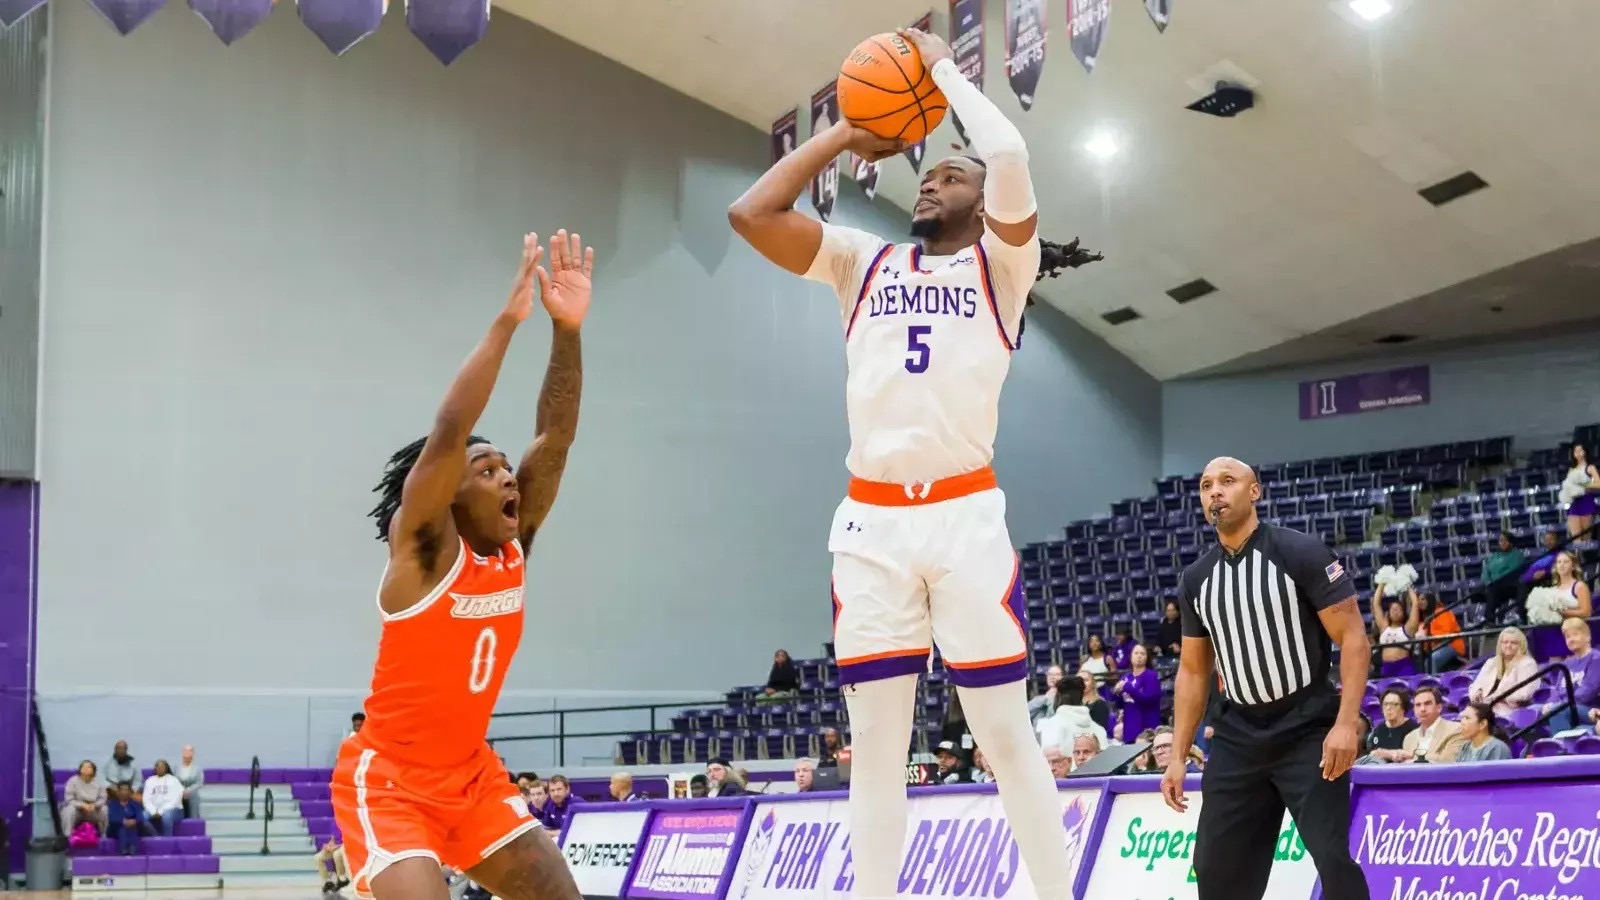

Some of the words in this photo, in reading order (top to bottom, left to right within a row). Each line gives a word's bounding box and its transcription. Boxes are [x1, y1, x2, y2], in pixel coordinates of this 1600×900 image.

[818, 167, 835, 204] 14
[869, 285, 977, 318] DEMONS
[905, 325, 931, 373] 5
[469, 627, 497, 694] 0
[568, 843, 637, 867] POWERADE
[656, 831, 735, 876] Alumni
[763, 822, 840, 890] FORK
[897, 817, 1019, 899] DEMONS
[1120, 817, 1198, 871] Super
[1355, 808, 1523, 867] Natchitoches
[649, 875, 720, 895] ASSOCIATION
